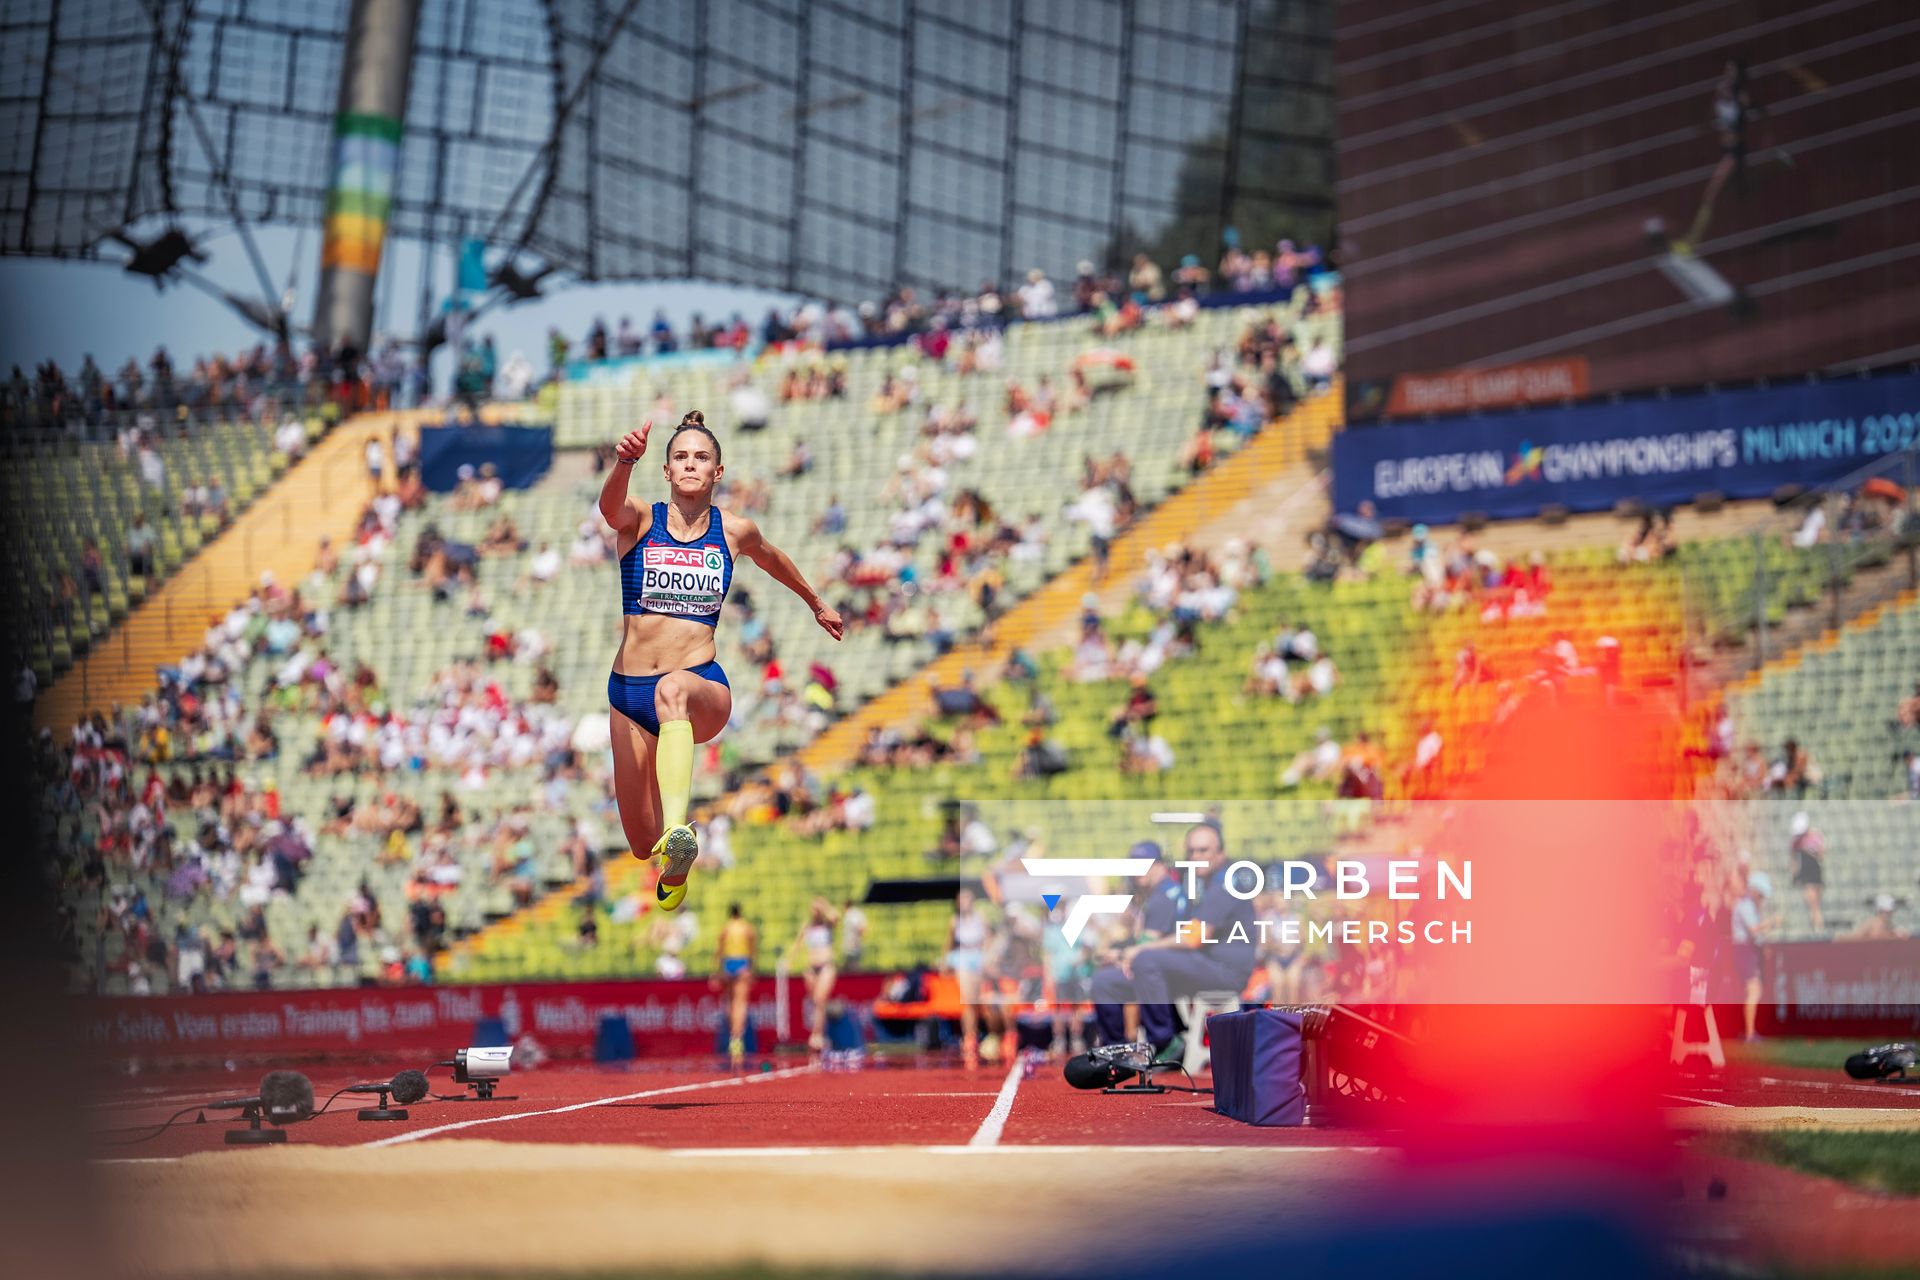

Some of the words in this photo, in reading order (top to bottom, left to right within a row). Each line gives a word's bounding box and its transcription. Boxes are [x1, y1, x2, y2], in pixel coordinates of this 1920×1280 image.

[1374, 451, 1503, 497] EUROPEAN
[1542, 429, 1737, 483] CHAMPIONSHIPS
[1743, 418, 1856, 464] MUNICH
[647, 551, 703, 565] SPAR
[646, 570, 720, 592] BOROVIC
[646, 600, 689, 613] MUNICH
[692, 603, 717, 613] 2022
[283, 1003, 360, 1042] Training
